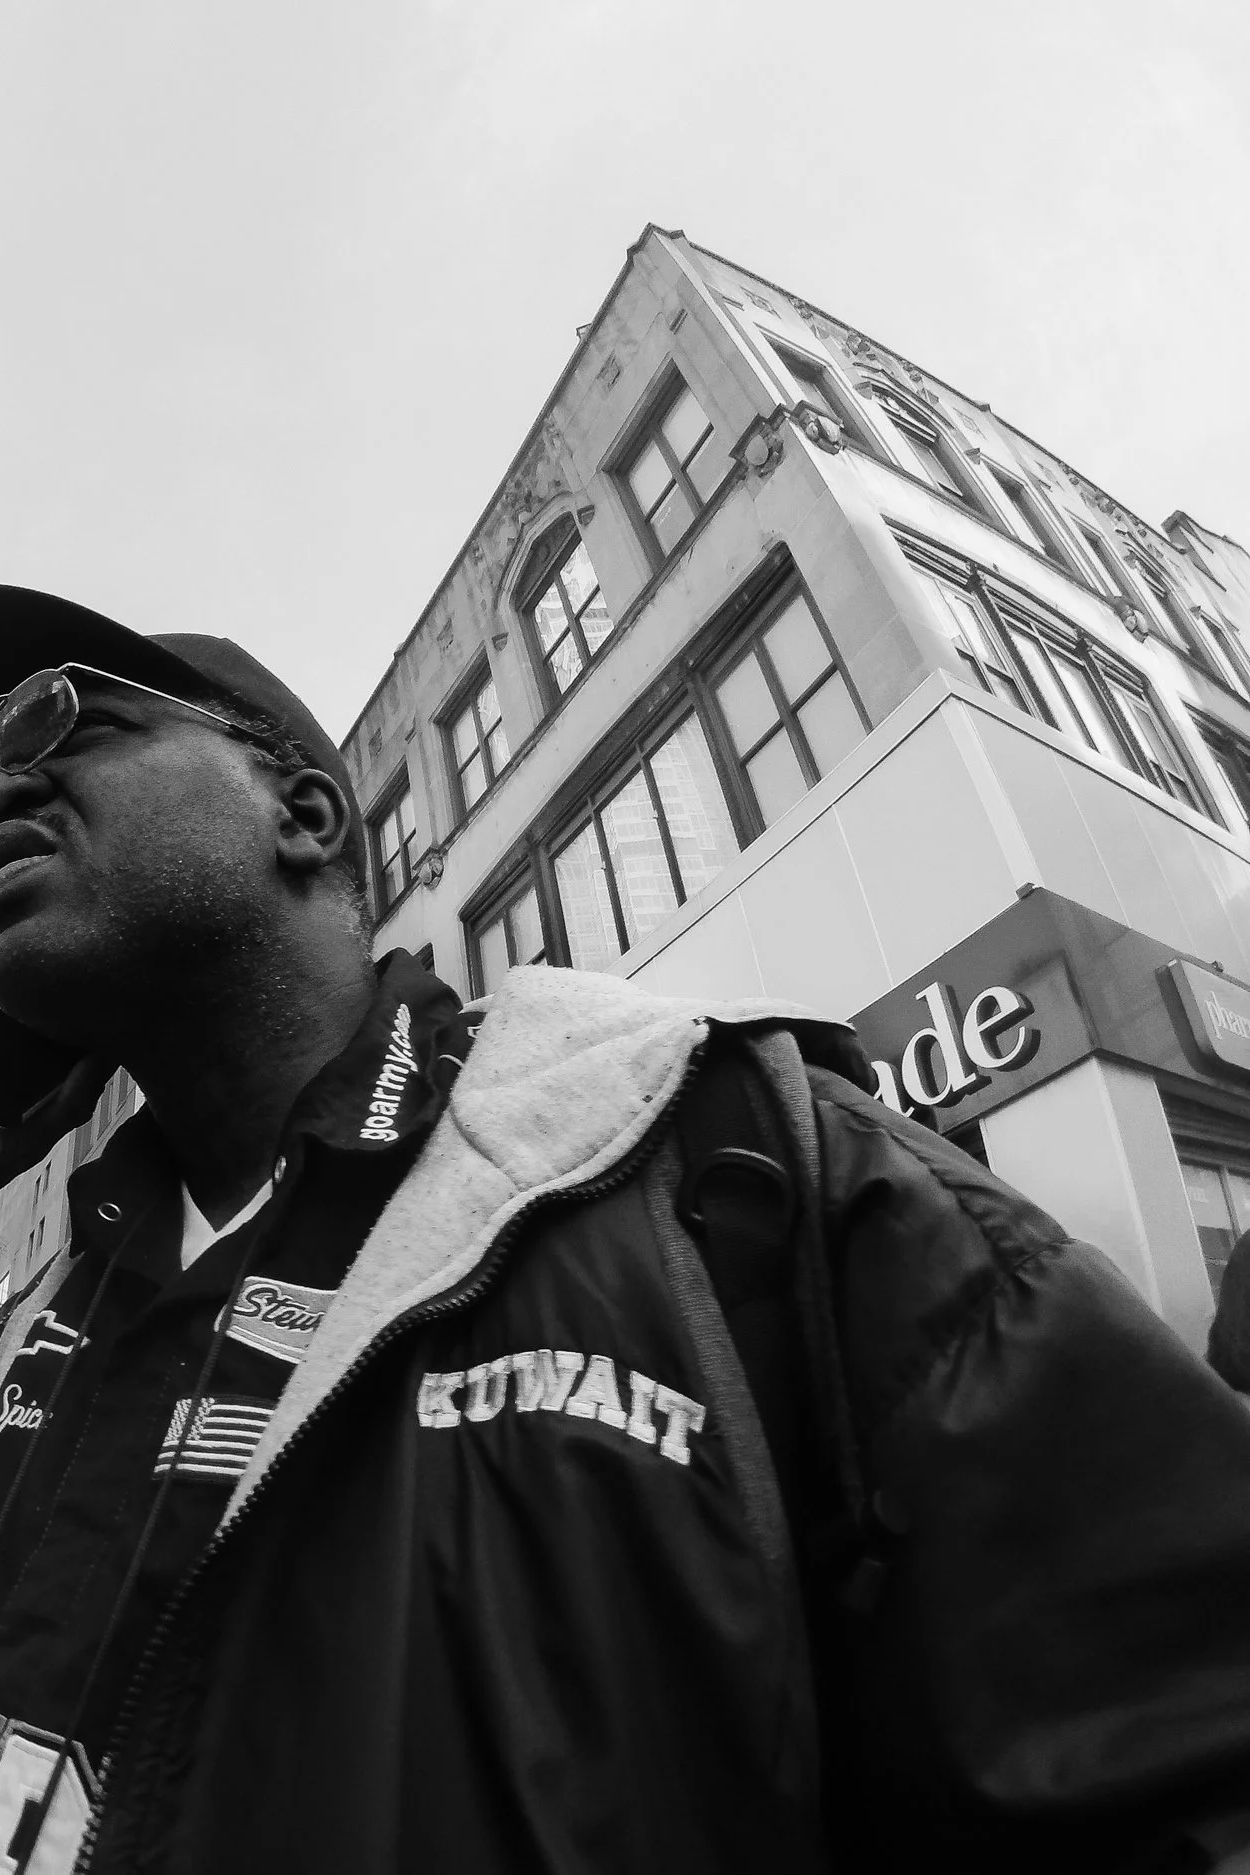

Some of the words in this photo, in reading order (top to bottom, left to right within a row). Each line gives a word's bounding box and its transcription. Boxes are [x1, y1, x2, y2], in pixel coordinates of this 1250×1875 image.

[359, 1003, 418, 1142] goarmy.com
[1204, 990, 1250, 1040] phar
[416, 1348, 707, 1467] KUWAIT
